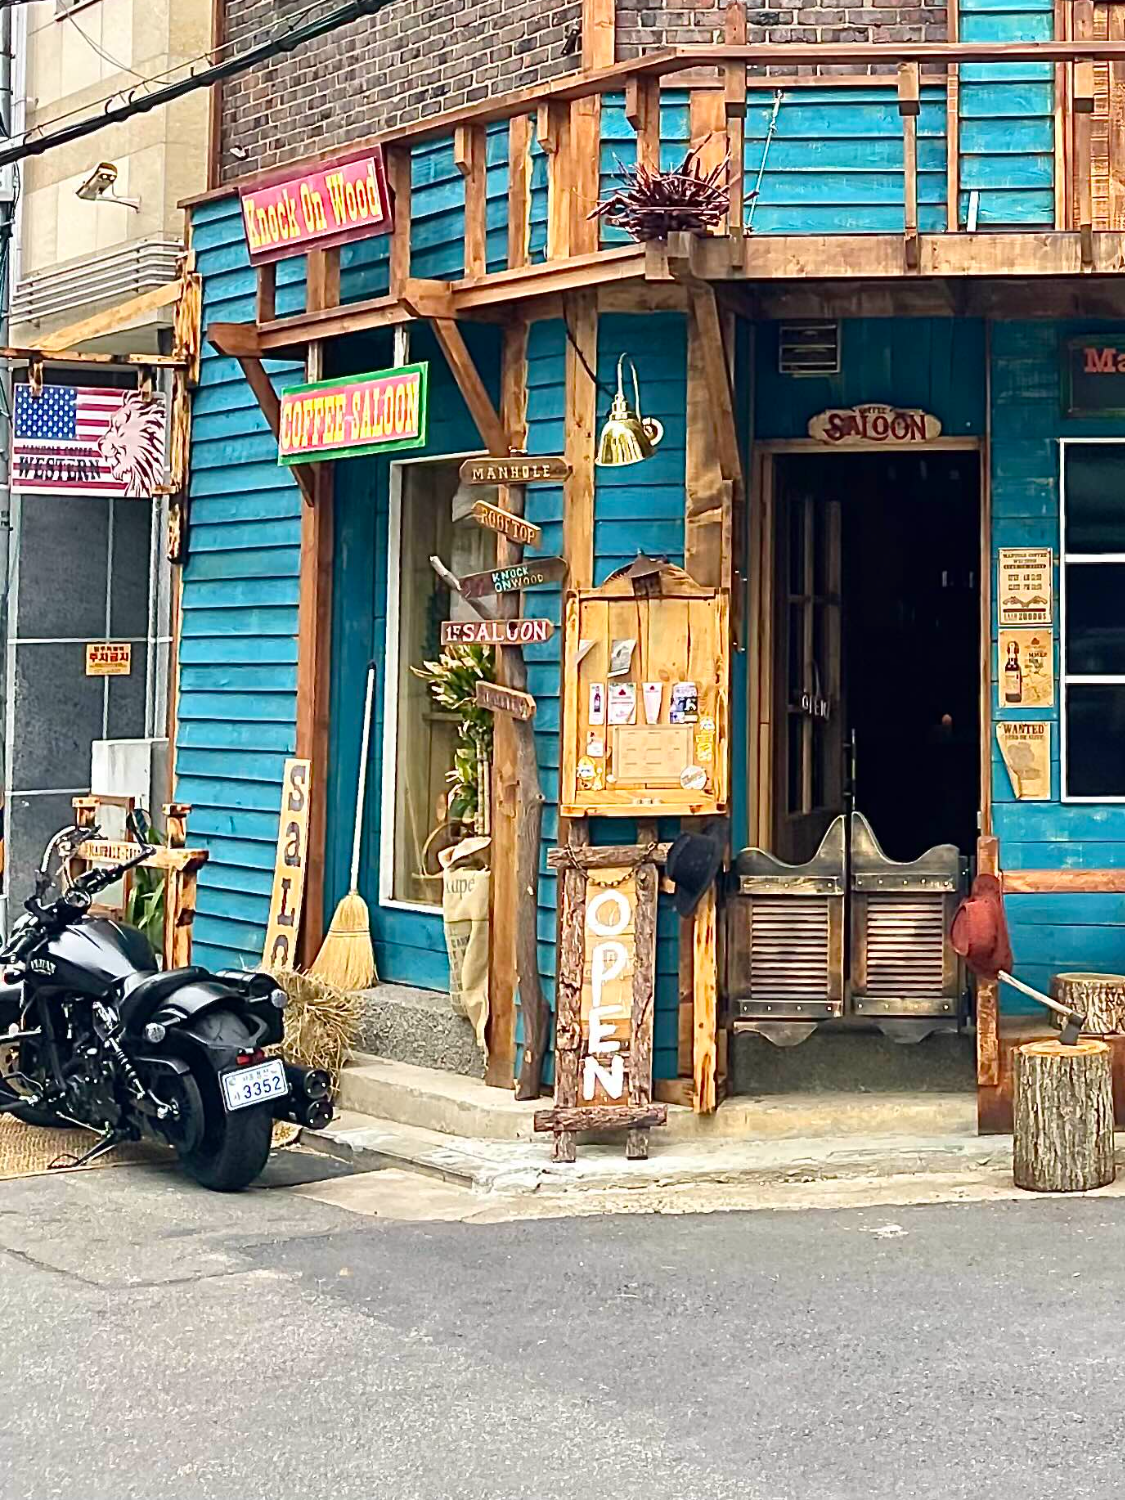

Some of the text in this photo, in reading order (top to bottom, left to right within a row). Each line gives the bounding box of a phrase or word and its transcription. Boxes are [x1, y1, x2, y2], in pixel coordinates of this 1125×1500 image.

[244, 163, 381, 248] Knock On Wood
[281, 380, 419, 450] COFFEE SALOON
[823, 412, 927, 441] SALOON
[19, 456, 101, 481] WESTERN
[472, 464, 551, 480] MANHOLE
[481, 508, 535, 544] ROOFTOP
[492, 566, 529, 582] KNOCK
[462, 621, 548, 642] SALOON
[1003, 724, 1045, 734] WANTED
[582, 888, 631, 1101] OPEN
[243, 1075, 282, 1099] 3352
